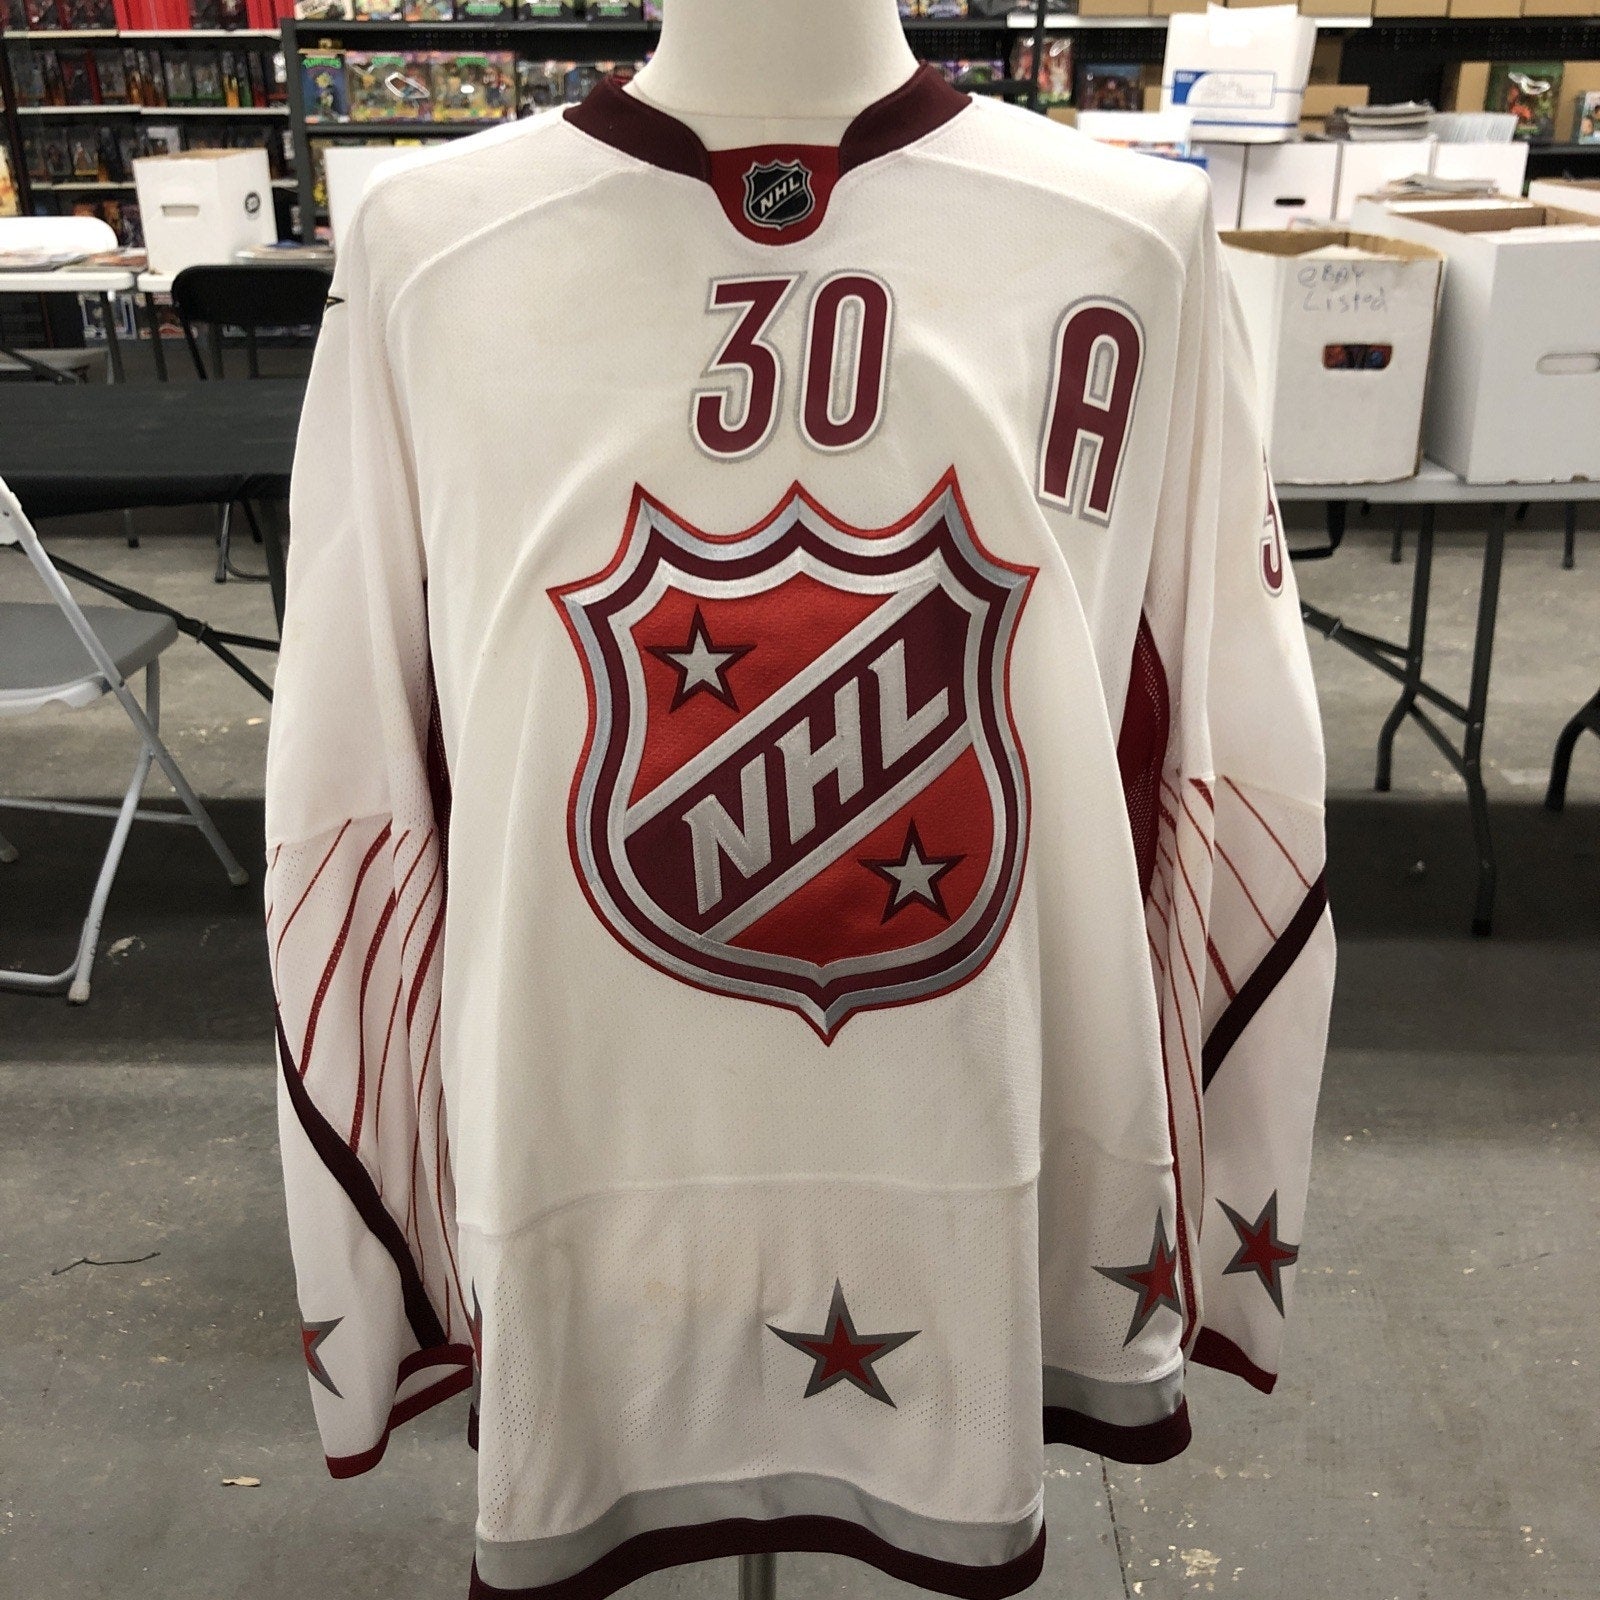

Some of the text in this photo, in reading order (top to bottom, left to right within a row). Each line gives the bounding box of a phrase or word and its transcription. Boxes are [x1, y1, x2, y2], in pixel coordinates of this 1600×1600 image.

[760, 177, 800, 214] NHL
[690, 268, 894, 463] 30
[1035, 295, 1146, 529] A
[681, 637, 950, 916] NHL
